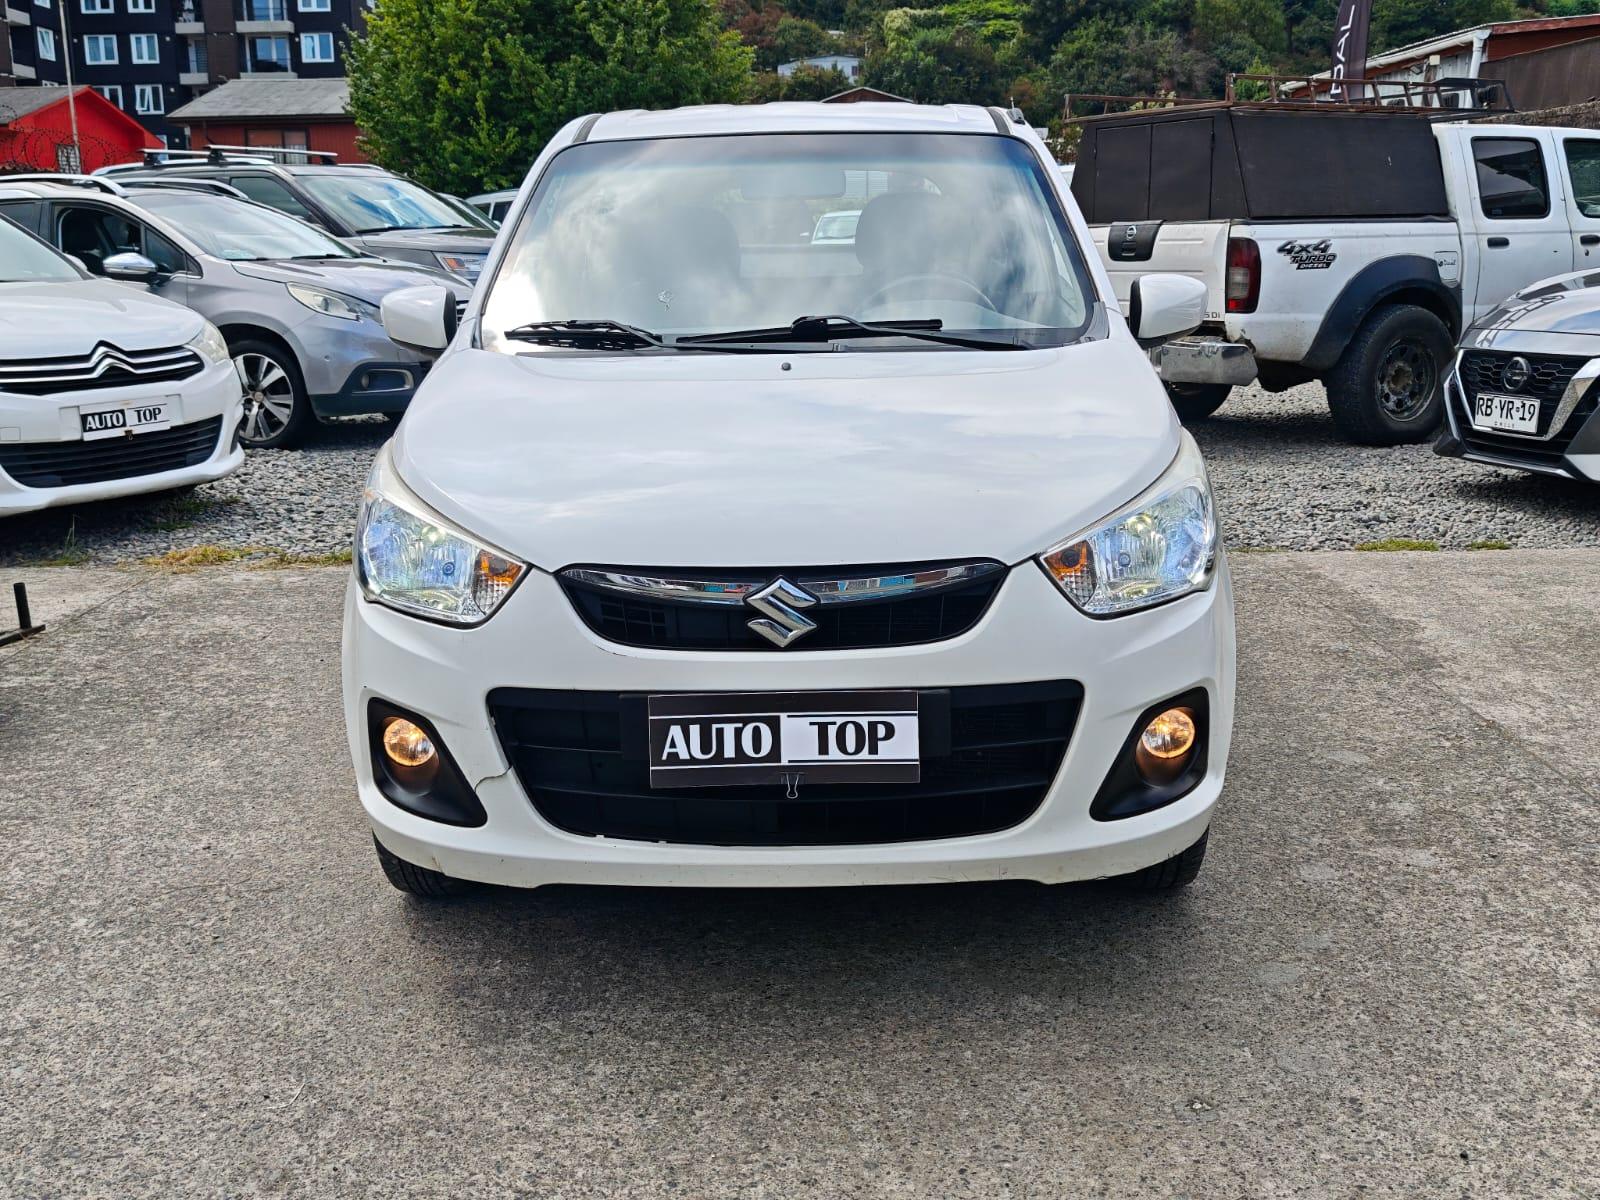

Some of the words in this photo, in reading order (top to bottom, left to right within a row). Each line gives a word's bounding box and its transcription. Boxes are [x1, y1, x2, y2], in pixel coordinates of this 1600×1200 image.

[1277, 239, 1332, 254] 4x4
[1290, 253, 1337, 264] TURBO
[86, 412, 123, 430] AUTO
[134, 407, 162, 424] TOP
[661, 722, 773, 761] AUTO
[809, 719, 896, 756] TOP
